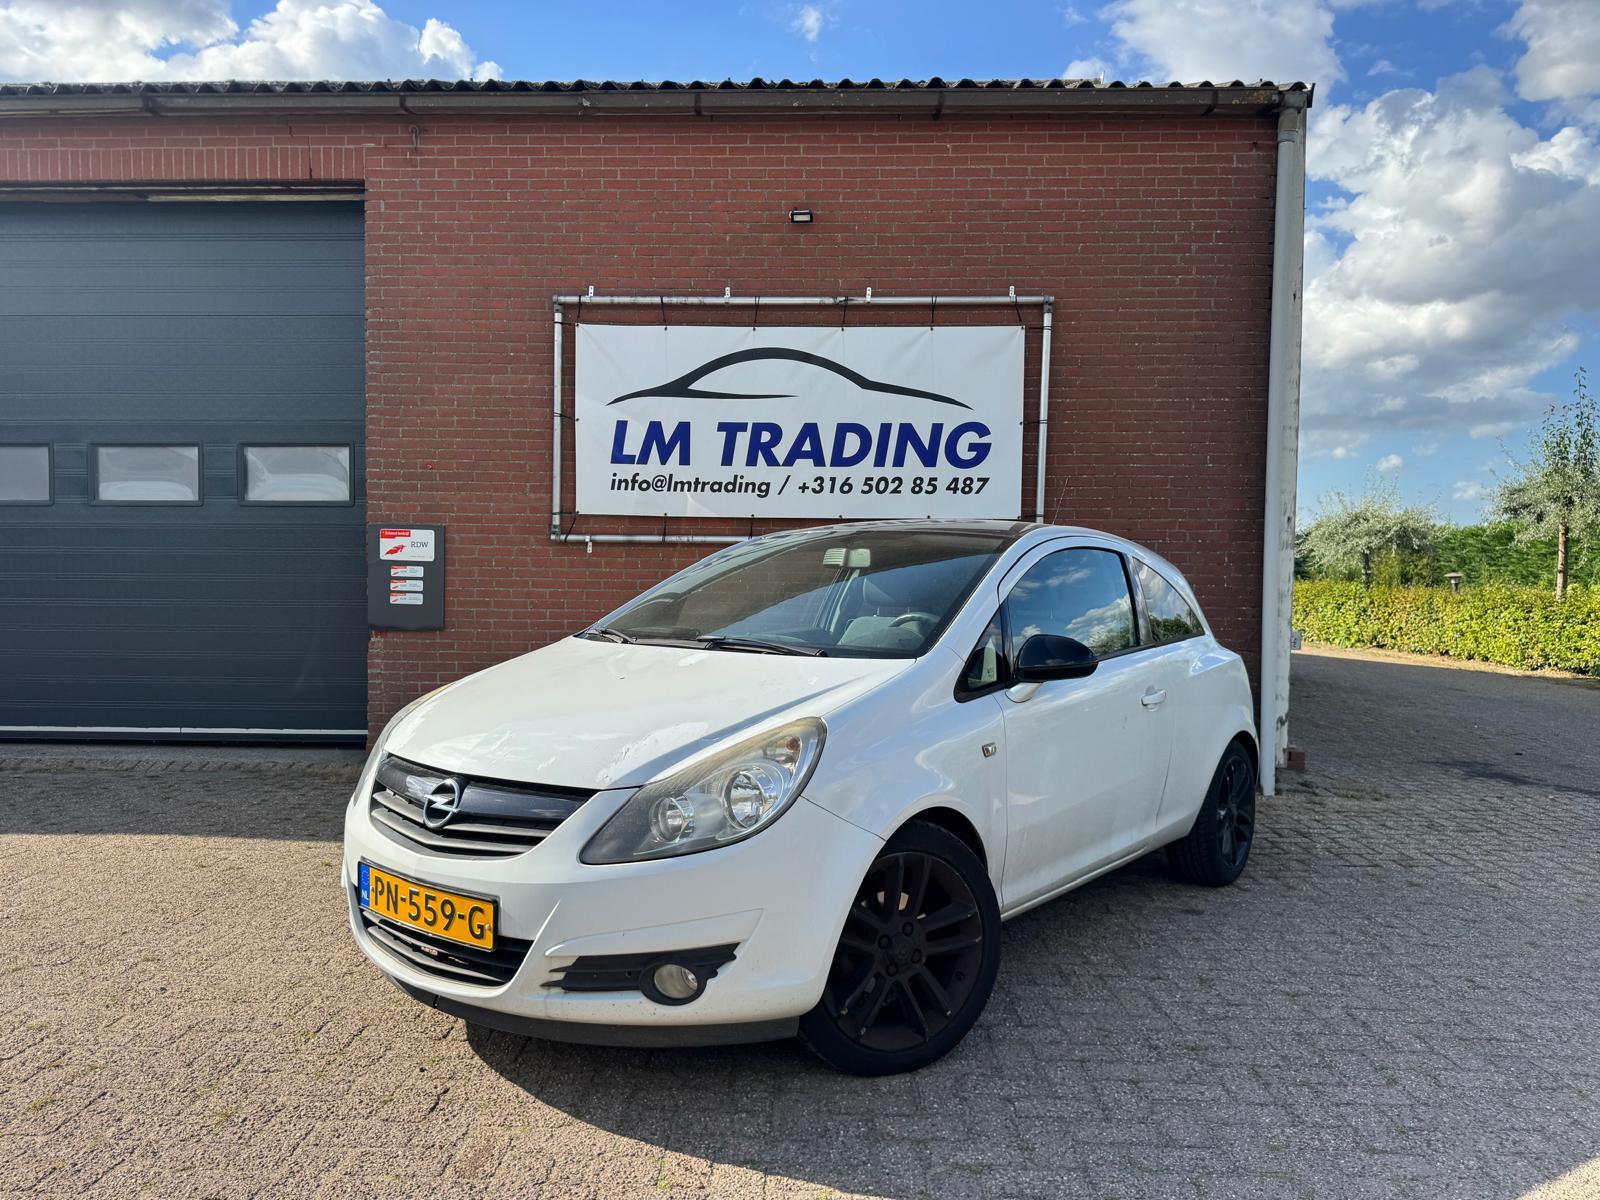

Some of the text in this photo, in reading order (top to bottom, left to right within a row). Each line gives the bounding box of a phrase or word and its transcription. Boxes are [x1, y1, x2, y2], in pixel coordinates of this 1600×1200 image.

[610, 420, 993, 470] LM TRADING
[610, 472, 991, 498] info@lmtrading / +316 502 85 487
[361, 889, 369, 900] NL
[374, 875, 486, 940] PN-559-G
